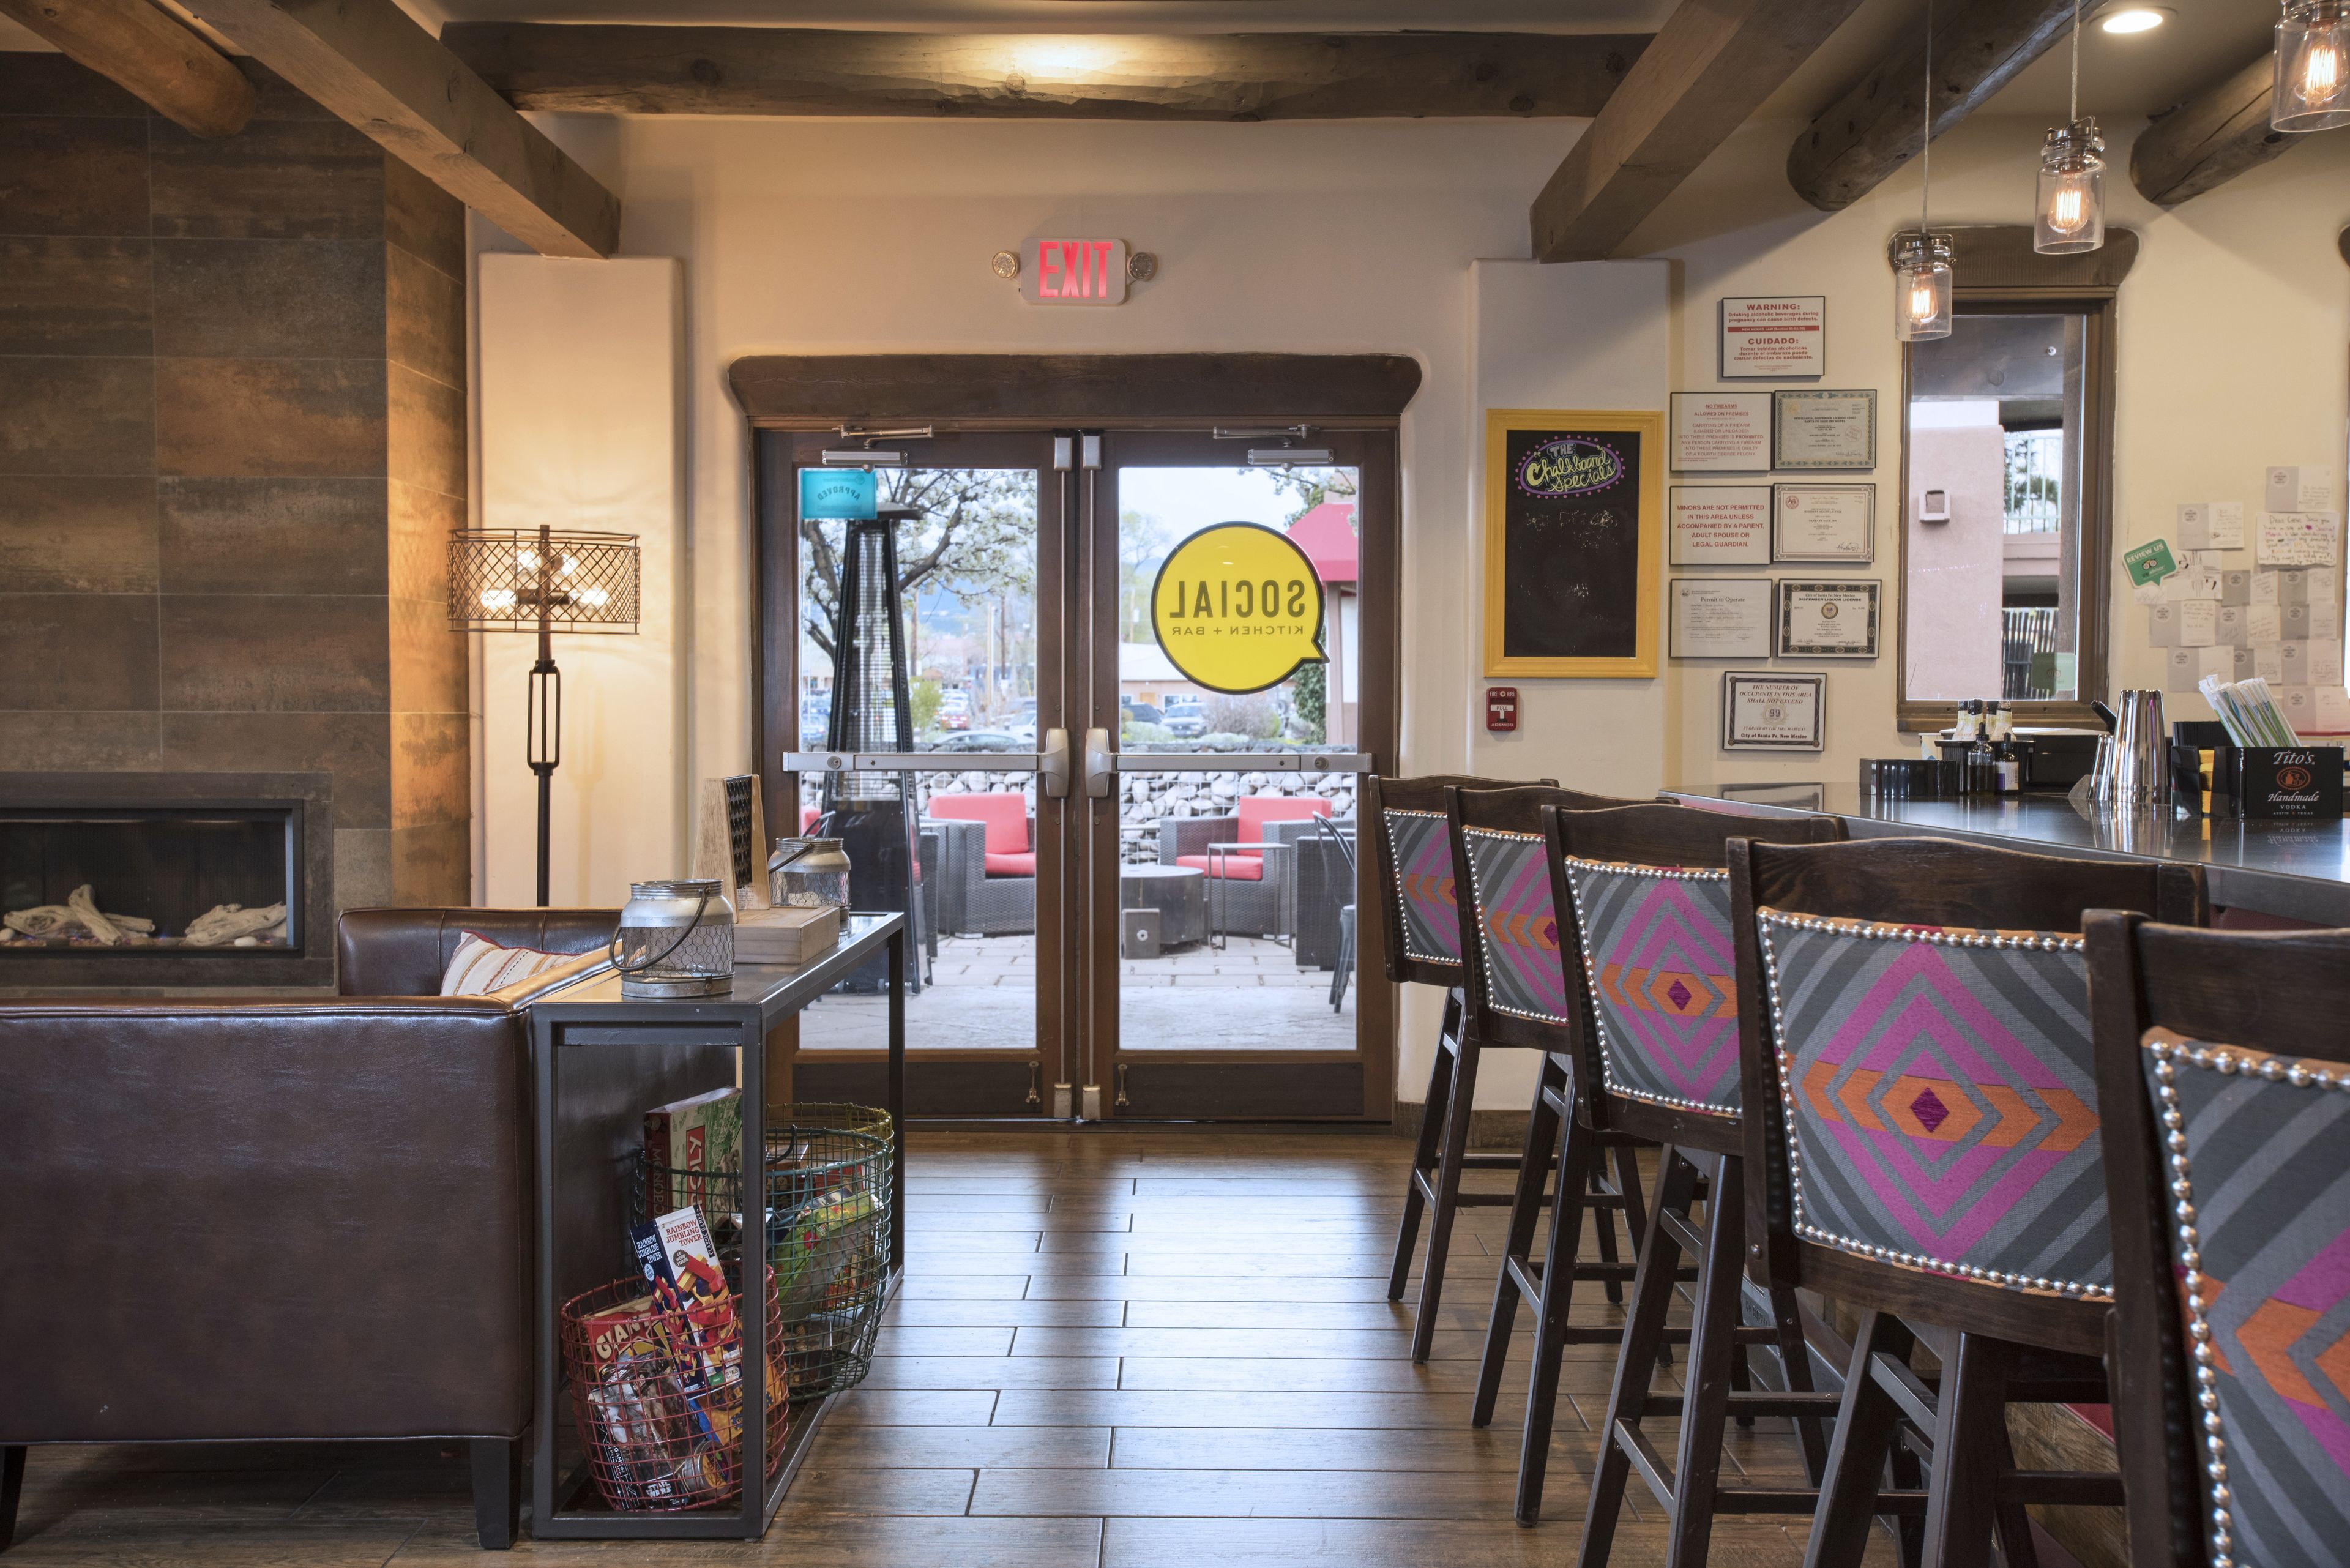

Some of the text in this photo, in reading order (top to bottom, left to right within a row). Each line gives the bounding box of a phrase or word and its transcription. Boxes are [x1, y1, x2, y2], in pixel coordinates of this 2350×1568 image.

[1039, 241, 1113, 297] EXIT
[1550, 444, 1574, 457] THE
[2127, 548, 2152, 563] REVIEW
[1770, 709, 1780, 717] 99
[2273, 750, 2315, 764] Tito's
[2267, 791, 2319, 801] Handmade
[666, 1219, 696, 1235] RAINBOW
[666, 1226, 699, 1243] JUMBLING
[696, 1213, 714, 1255] CLASSIC GAMES
[636, 1234, 656, 1250] RAINBOW
[679, 1234, 702, 1246] TOWER
[638, 1243, 659, 1258] JUMBLING
[647, 1252, 662, 1263] TOWER
